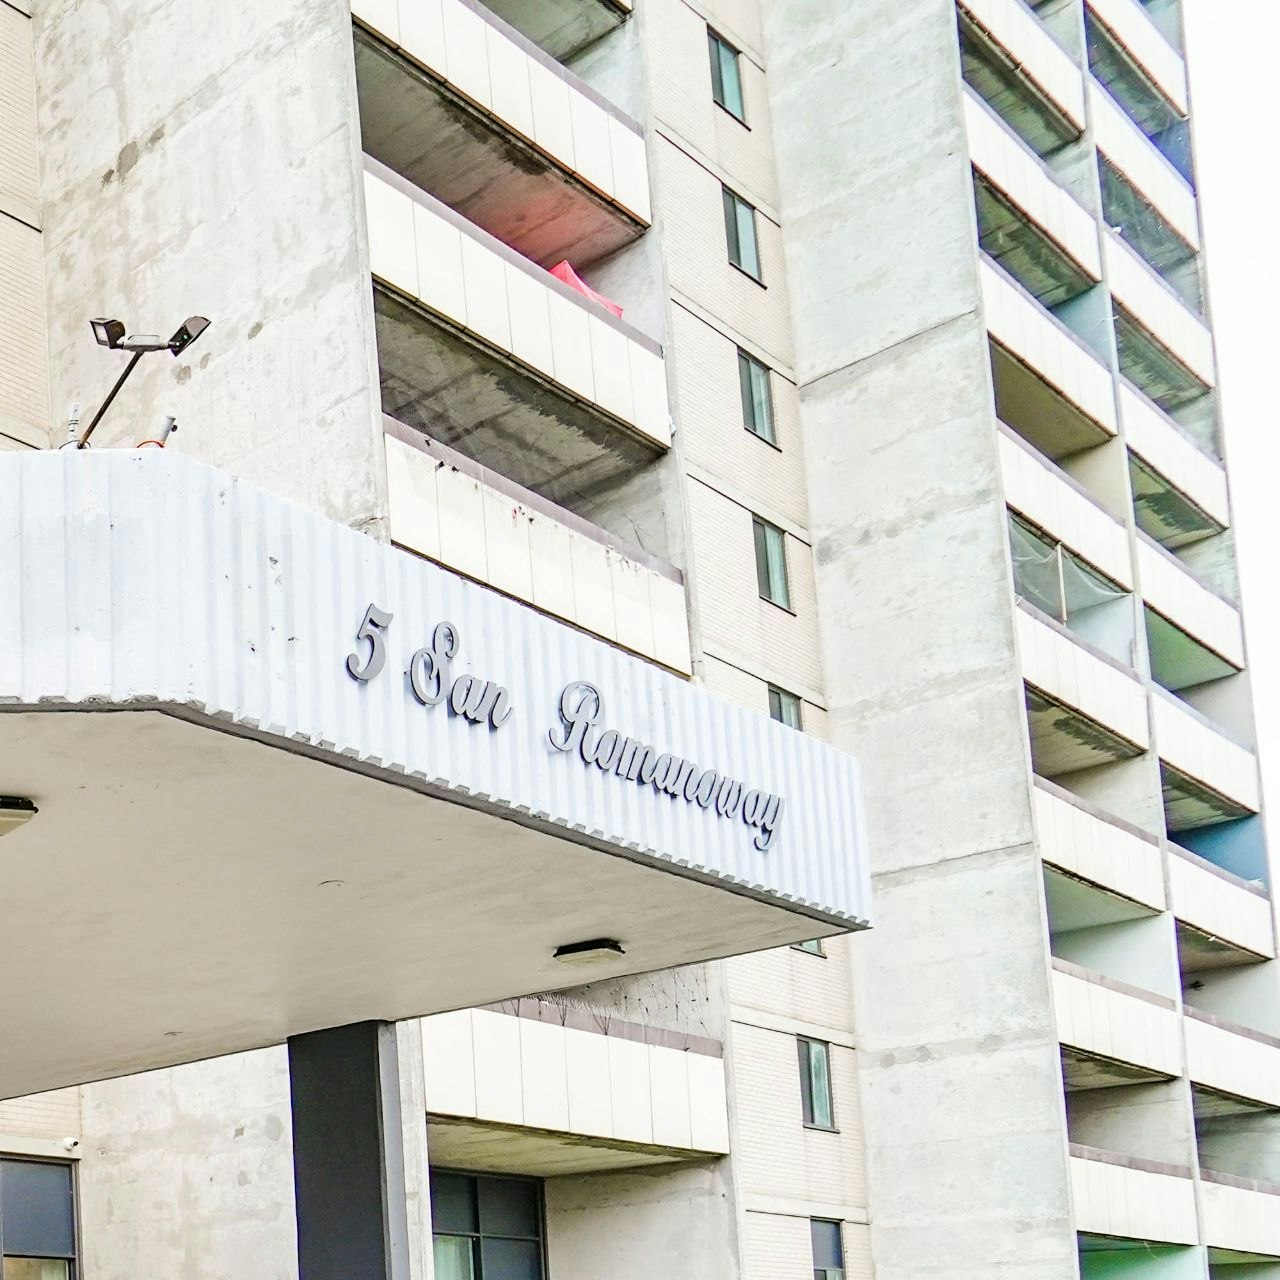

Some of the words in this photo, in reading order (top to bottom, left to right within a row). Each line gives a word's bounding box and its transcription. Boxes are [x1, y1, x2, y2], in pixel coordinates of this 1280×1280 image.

[346, 602, 394, 681] 5
[406, 620, 514, 730] San
[547, 679, 785, 852] Romanoway
